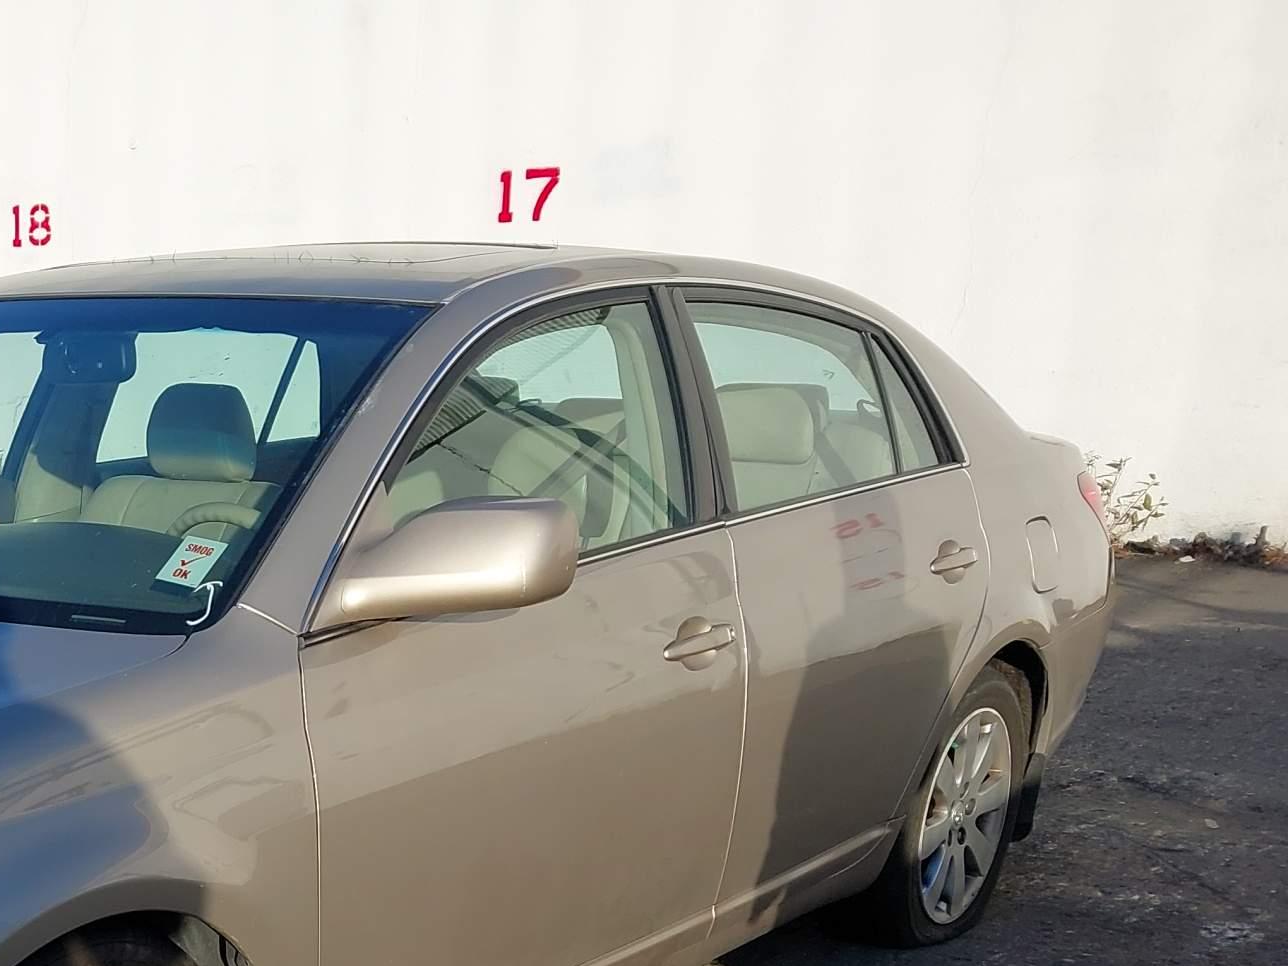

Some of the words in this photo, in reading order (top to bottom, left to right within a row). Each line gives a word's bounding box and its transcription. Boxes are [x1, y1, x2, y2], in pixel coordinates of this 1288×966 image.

[497, 166, 561, 224] 17
[11, 204, 52, 249] 18
[185, 543, 215, 557] SMOG
[172, 568, 192, 580] OK
